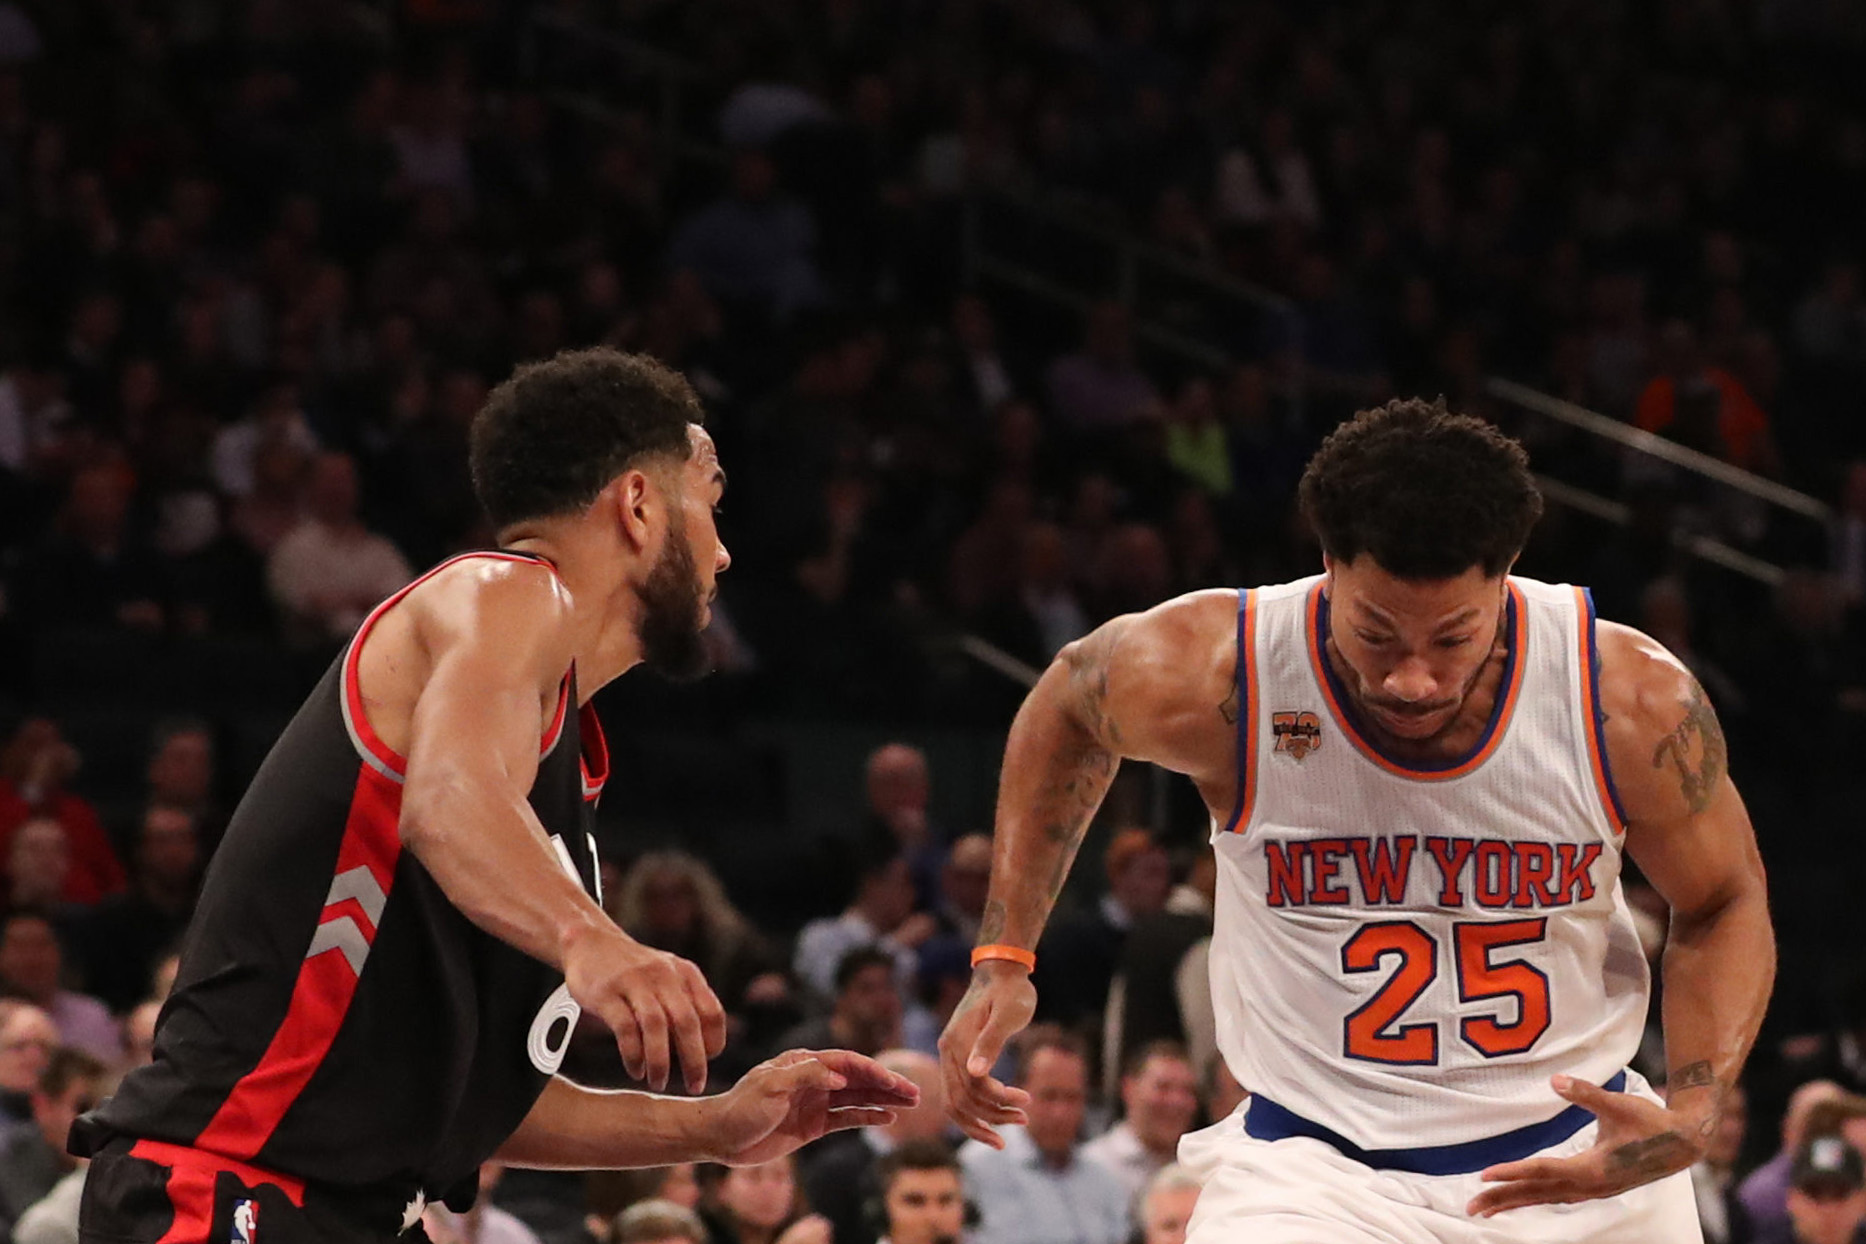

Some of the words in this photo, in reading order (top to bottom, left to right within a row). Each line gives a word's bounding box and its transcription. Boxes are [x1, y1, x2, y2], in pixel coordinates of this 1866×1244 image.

[1264, 835, 1417, 907] NEW
[1425, 837, 1603, 908] YORK
[1340, 917, 1552, 1066] 25
